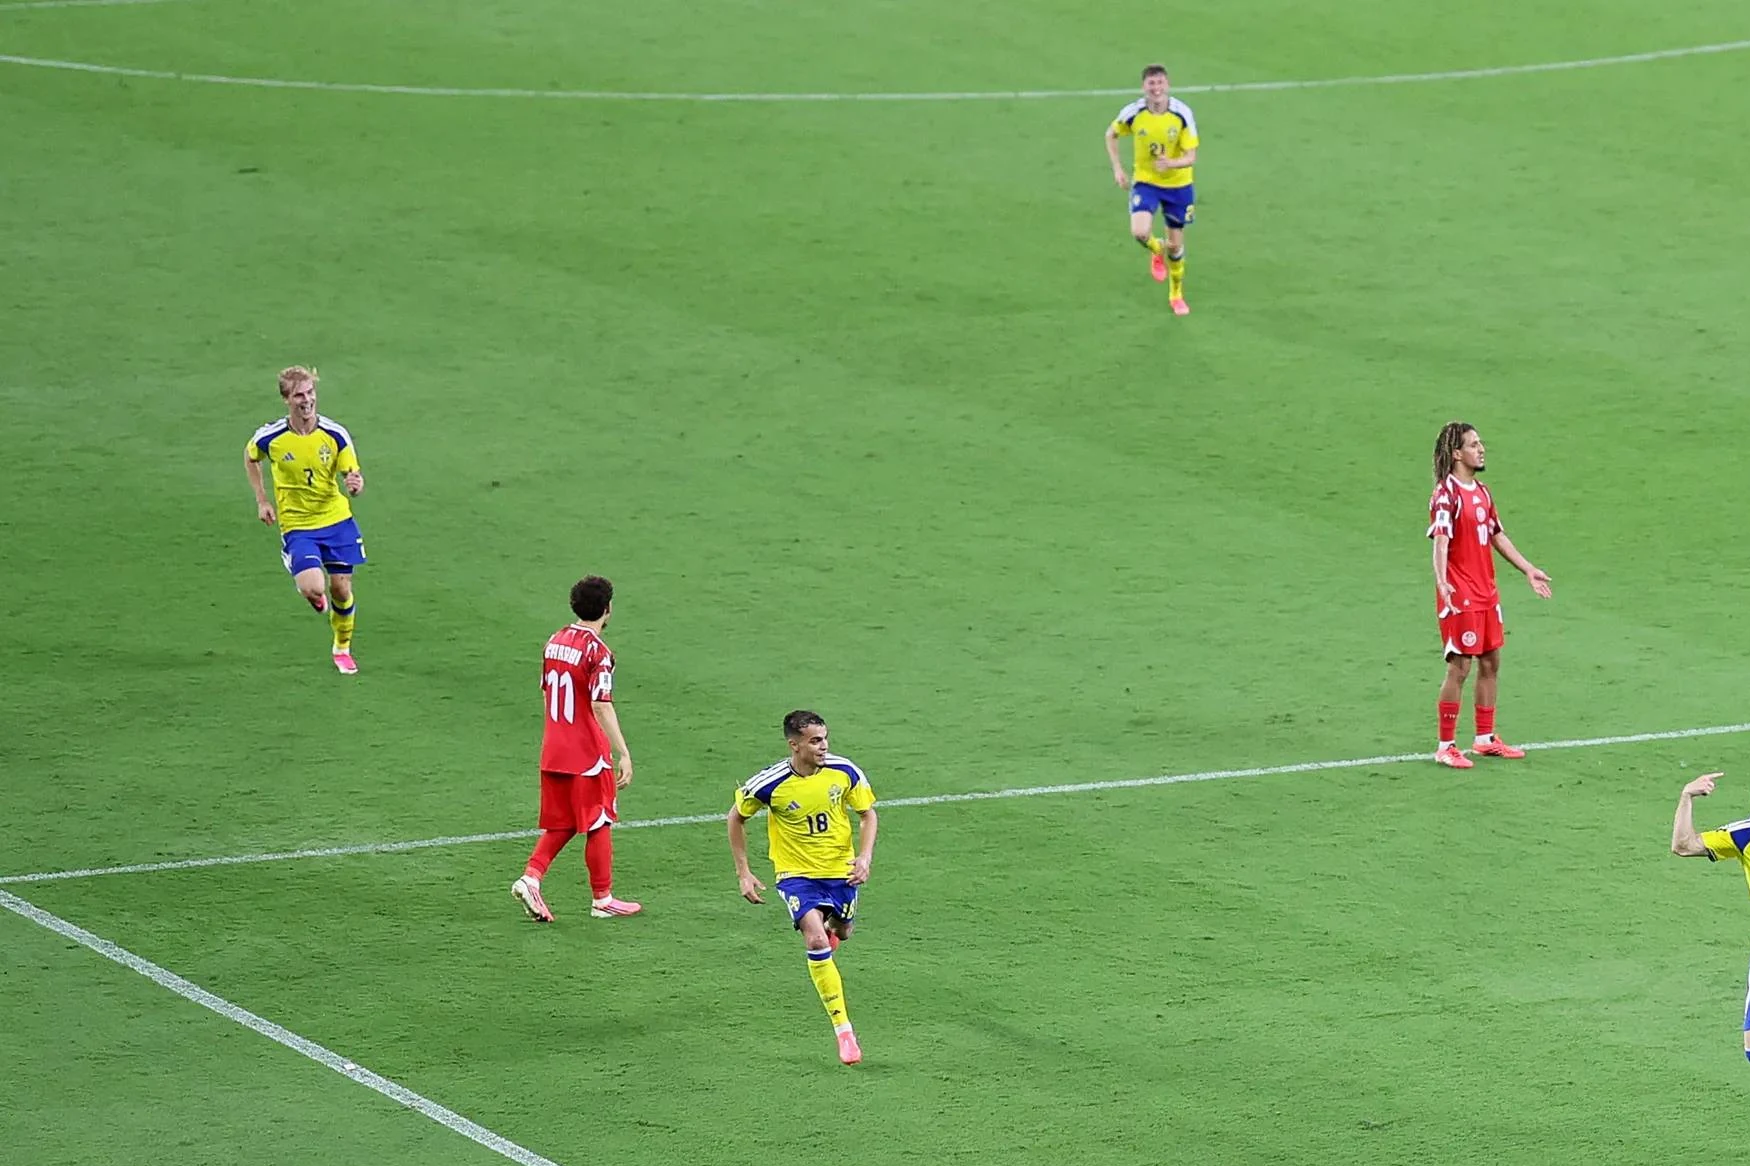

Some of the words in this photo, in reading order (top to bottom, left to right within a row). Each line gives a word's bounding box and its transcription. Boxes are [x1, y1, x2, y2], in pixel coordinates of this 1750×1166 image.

[303, 468, 314, 486] 7
[1476, 523, 1489, 546] 10
[546, 669, 575, 725] 11
[806, 812, 829, 835] 18
